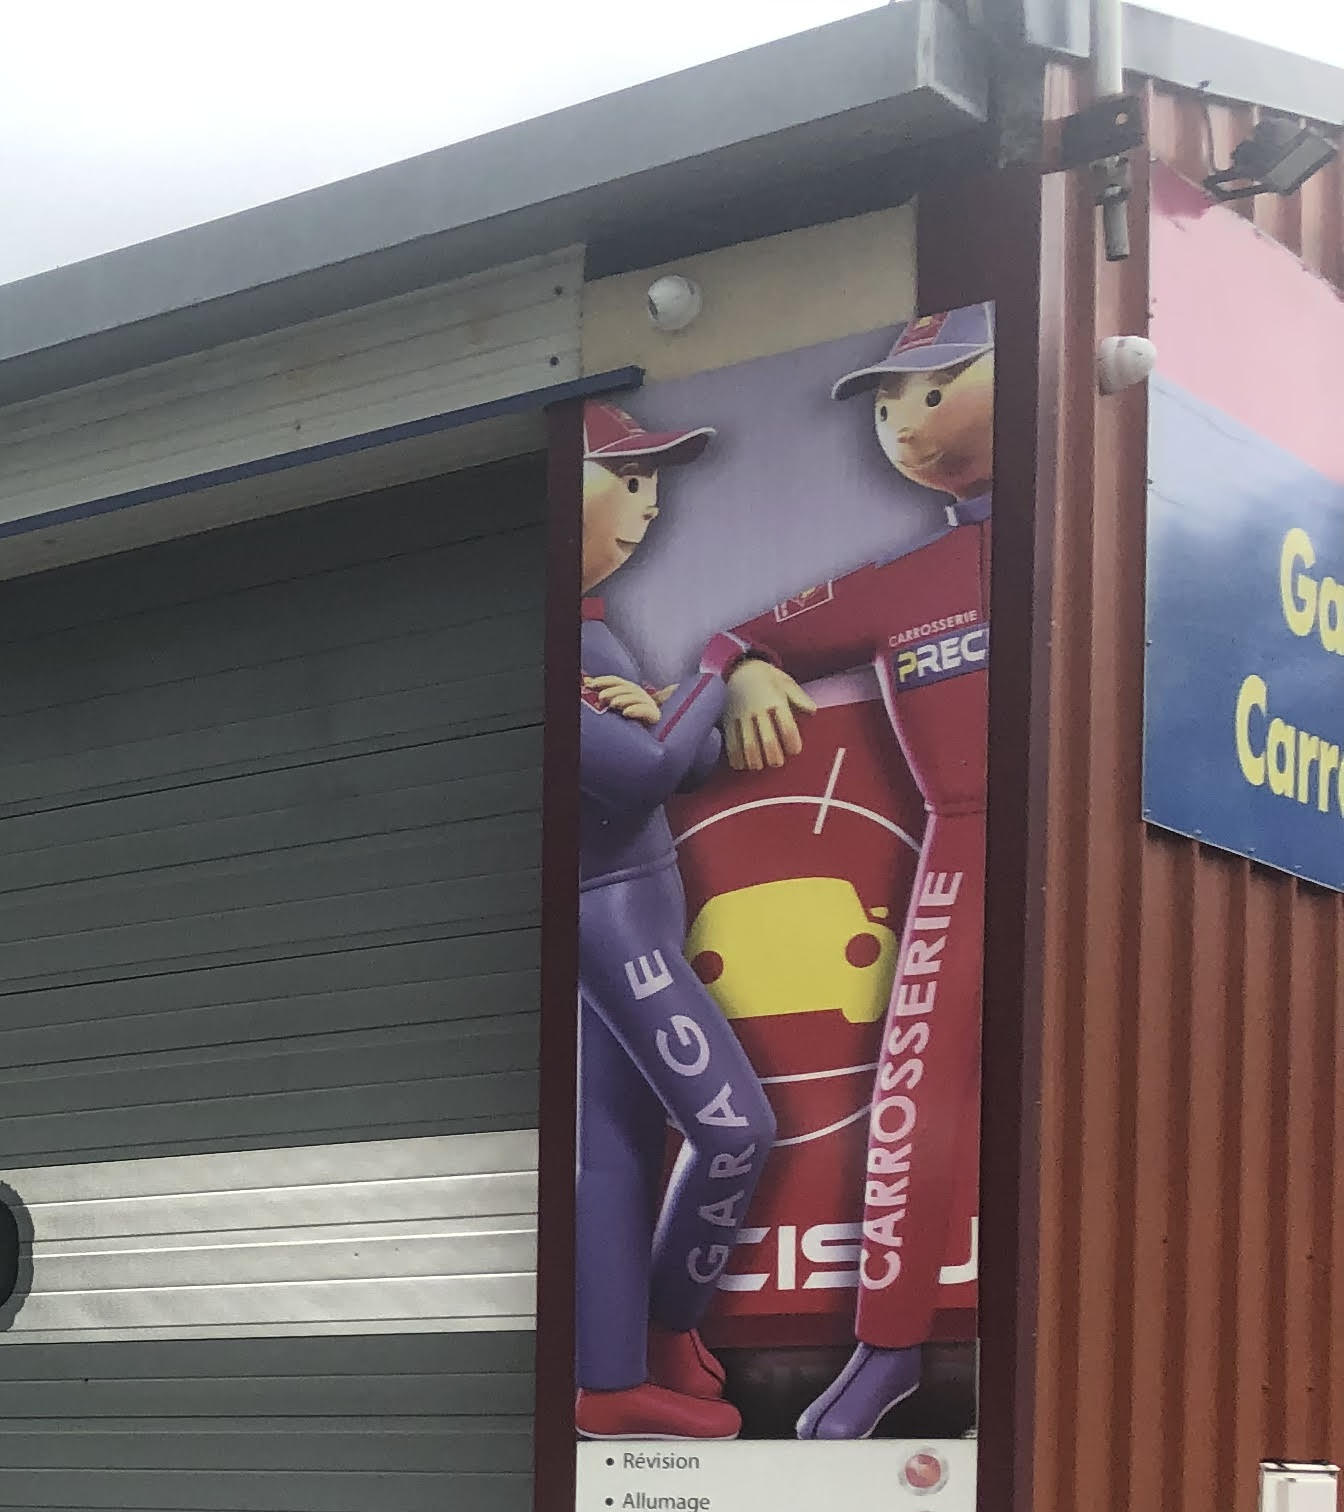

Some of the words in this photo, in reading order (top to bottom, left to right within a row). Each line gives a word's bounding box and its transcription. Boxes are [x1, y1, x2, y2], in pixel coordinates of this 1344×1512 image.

[888, 609, 978, 648] CARROSSERIE
[1235, 674, 1344, 819] Carr
[624, 948, 758, 1285] GARAGE
[859, 871, 964, 1291] CARROSSERIE
[623, 1451, 700, 1470] Révision
